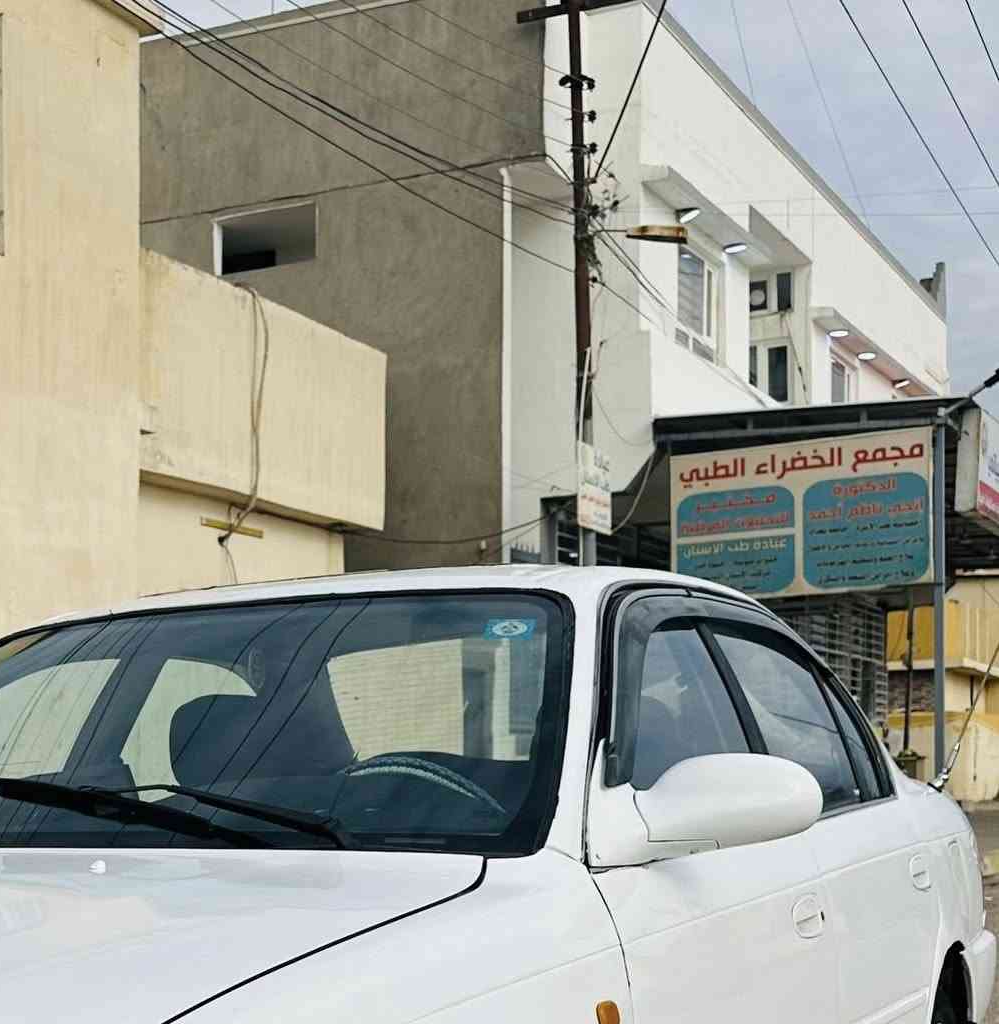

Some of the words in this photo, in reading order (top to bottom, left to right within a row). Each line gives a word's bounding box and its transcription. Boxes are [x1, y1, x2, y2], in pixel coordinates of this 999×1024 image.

[679, 457, 745, 488] الطبي
[755, 446, 842, 480] الخضراء
[852, 443, 924, 472] مجمع
